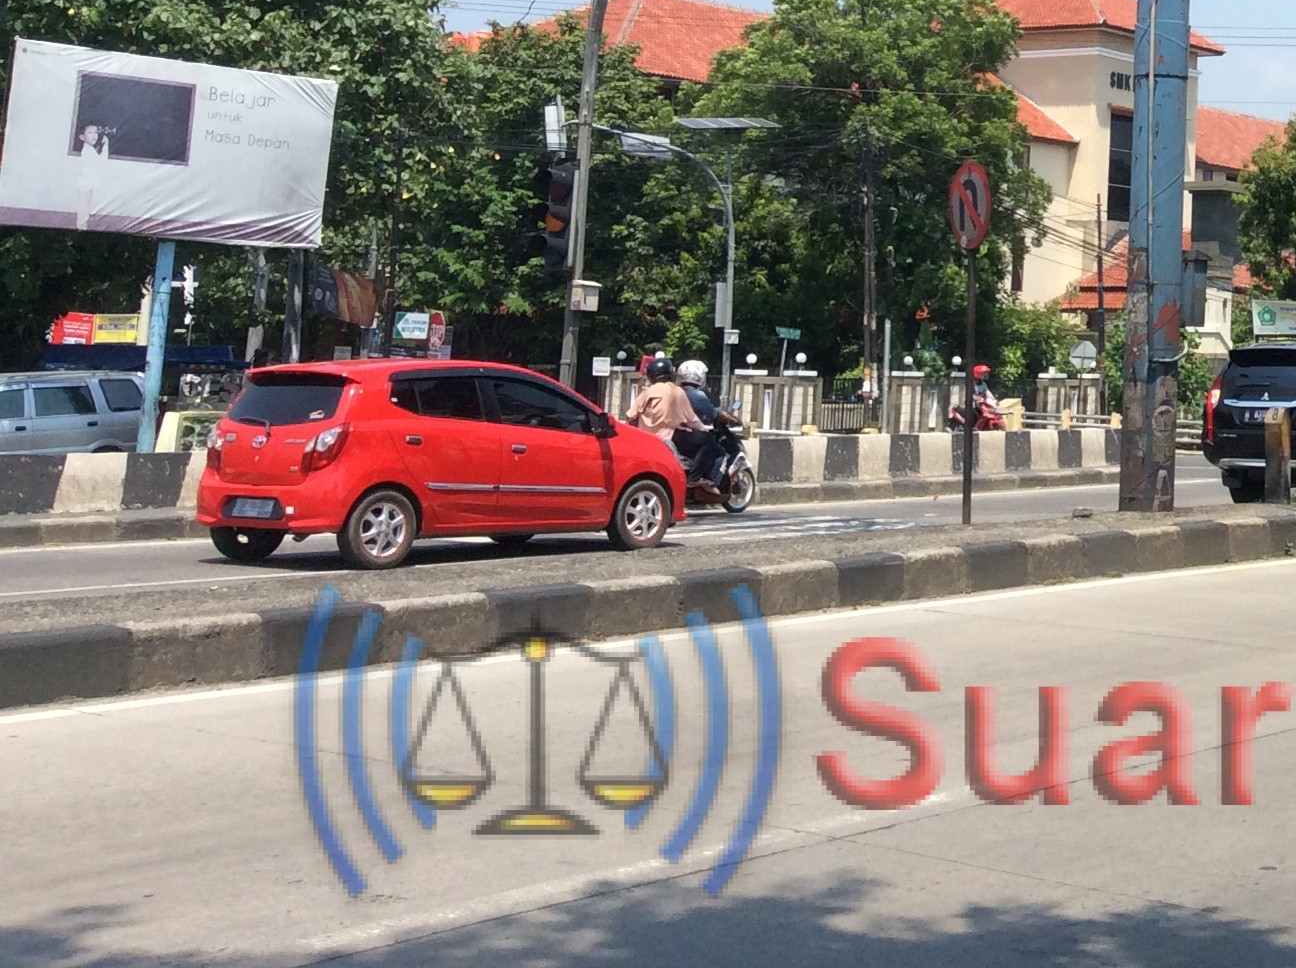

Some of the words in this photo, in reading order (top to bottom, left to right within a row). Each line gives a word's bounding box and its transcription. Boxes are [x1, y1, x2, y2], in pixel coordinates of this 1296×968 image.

[1110, 71, 1131, 92] SMK
[209, 86, 276, 109] Belajar
[207, 111, 242, 123] untuk
[205, 129, 240, 145] Masa
[247, 133, 290, 150] Depan
